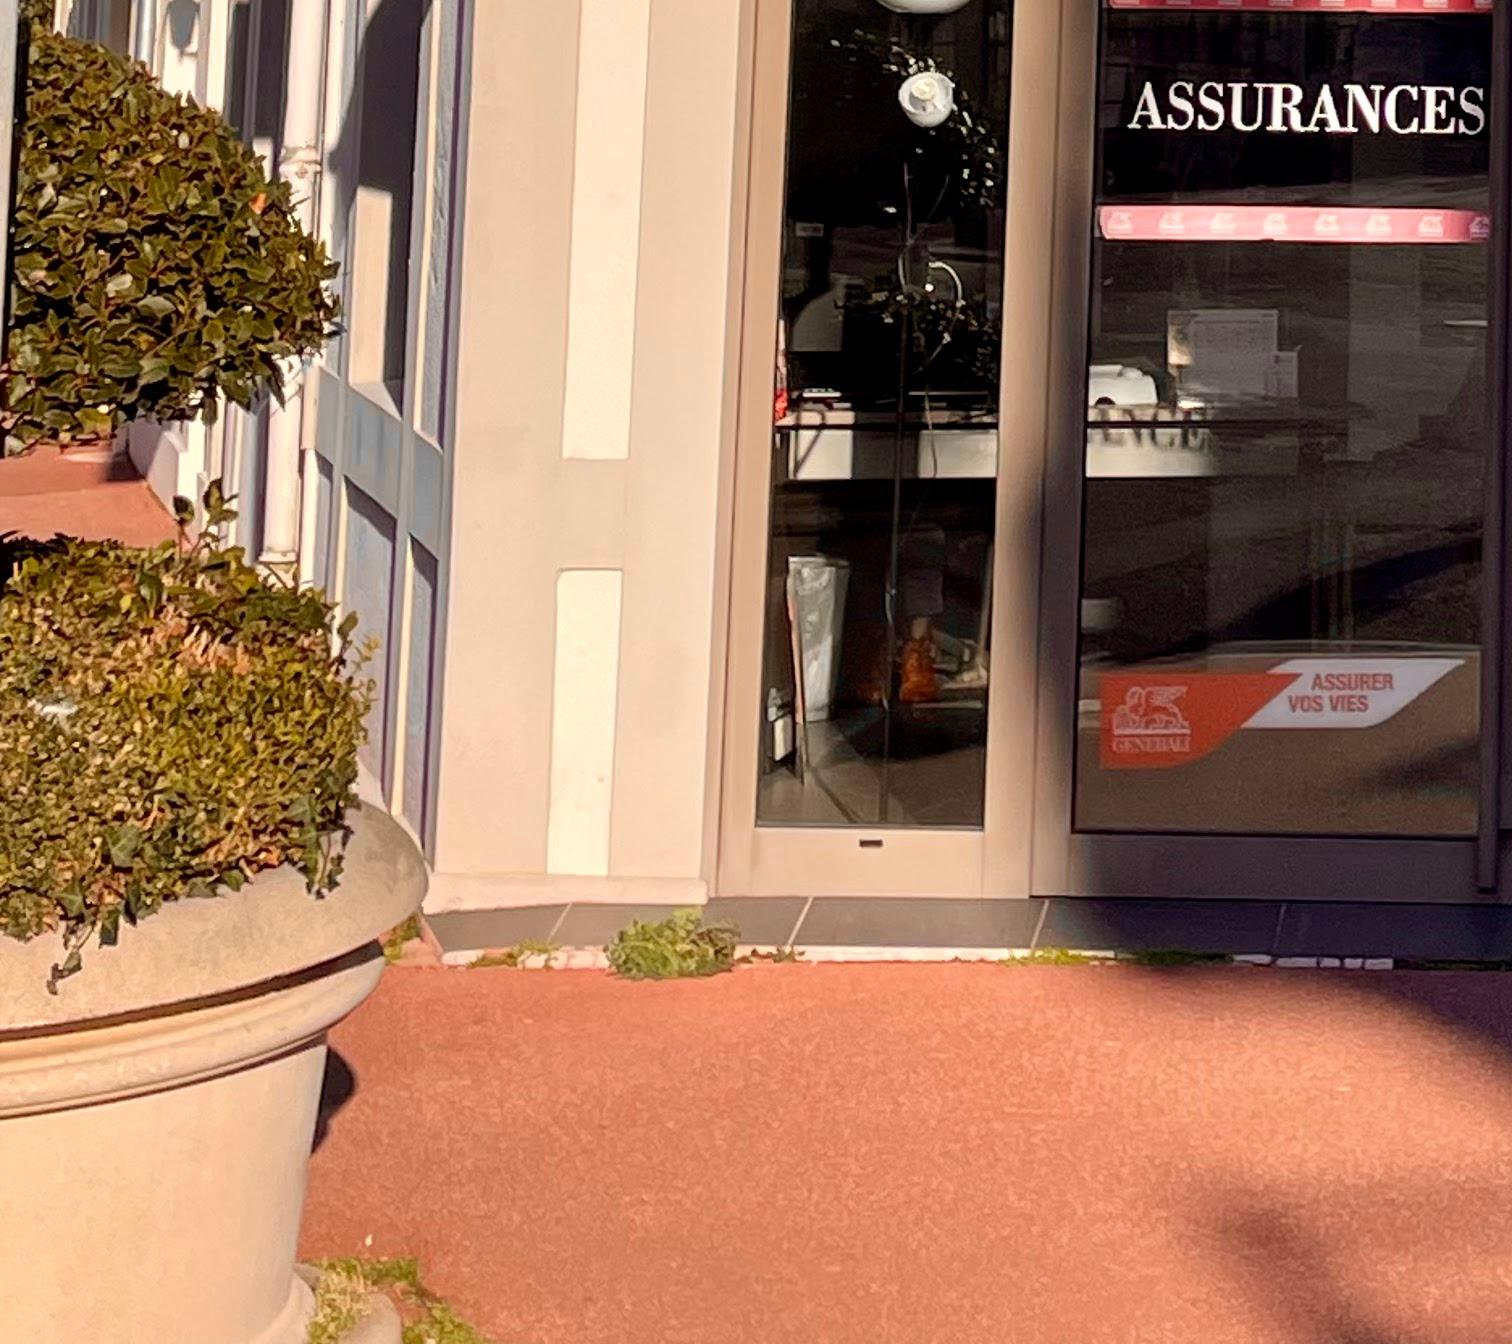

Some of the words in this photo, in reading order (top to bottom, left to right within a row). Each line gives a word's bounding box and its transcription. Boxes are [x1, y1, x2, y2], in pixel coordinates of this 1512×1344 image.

[1128, 81, 1485, 135] ASSURANCES
[1311, 673, 1394, 690] ASSURER
[1288, 696, 1323, 712] VOS
[1329, 695, 1369, 712] VIES
[1112, 736, 1191, 753] GENERALI
